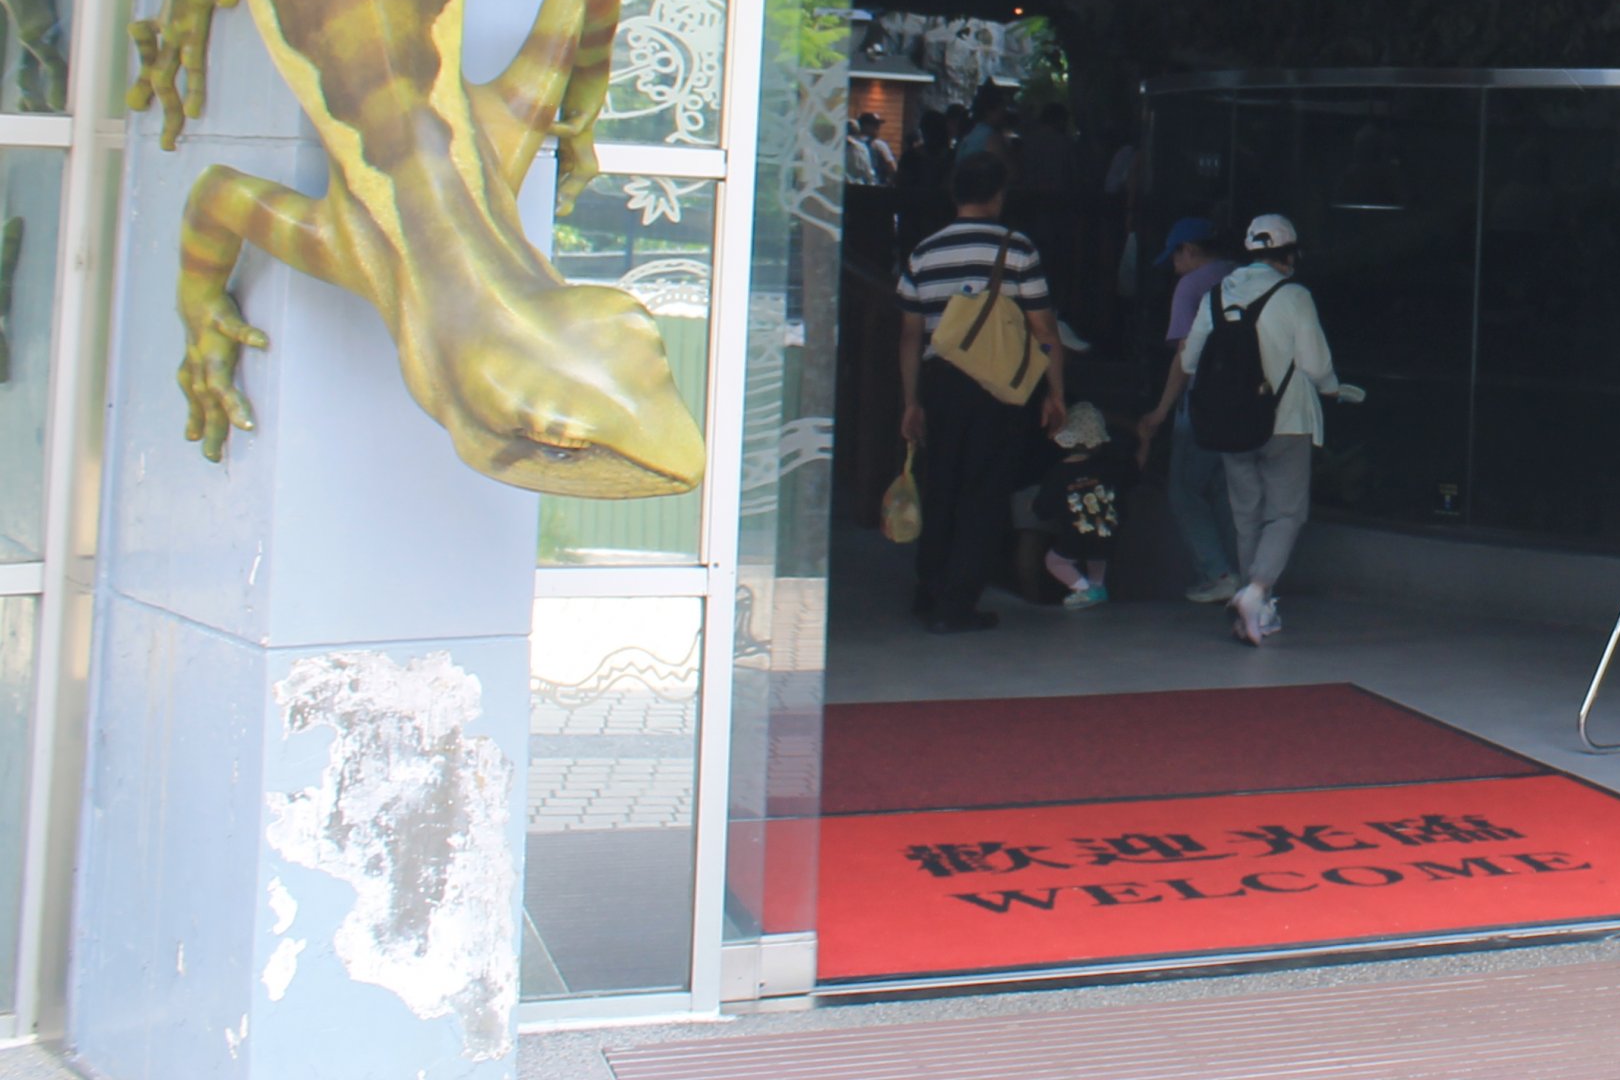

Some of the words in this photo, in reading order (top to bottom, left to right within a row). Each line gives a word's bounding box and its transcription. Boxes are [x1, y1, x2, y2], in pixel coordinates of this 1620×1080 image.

[904, 814, 1527, 877] 歡迎光臨
[946, 852, 1592, 913] WELCOME
